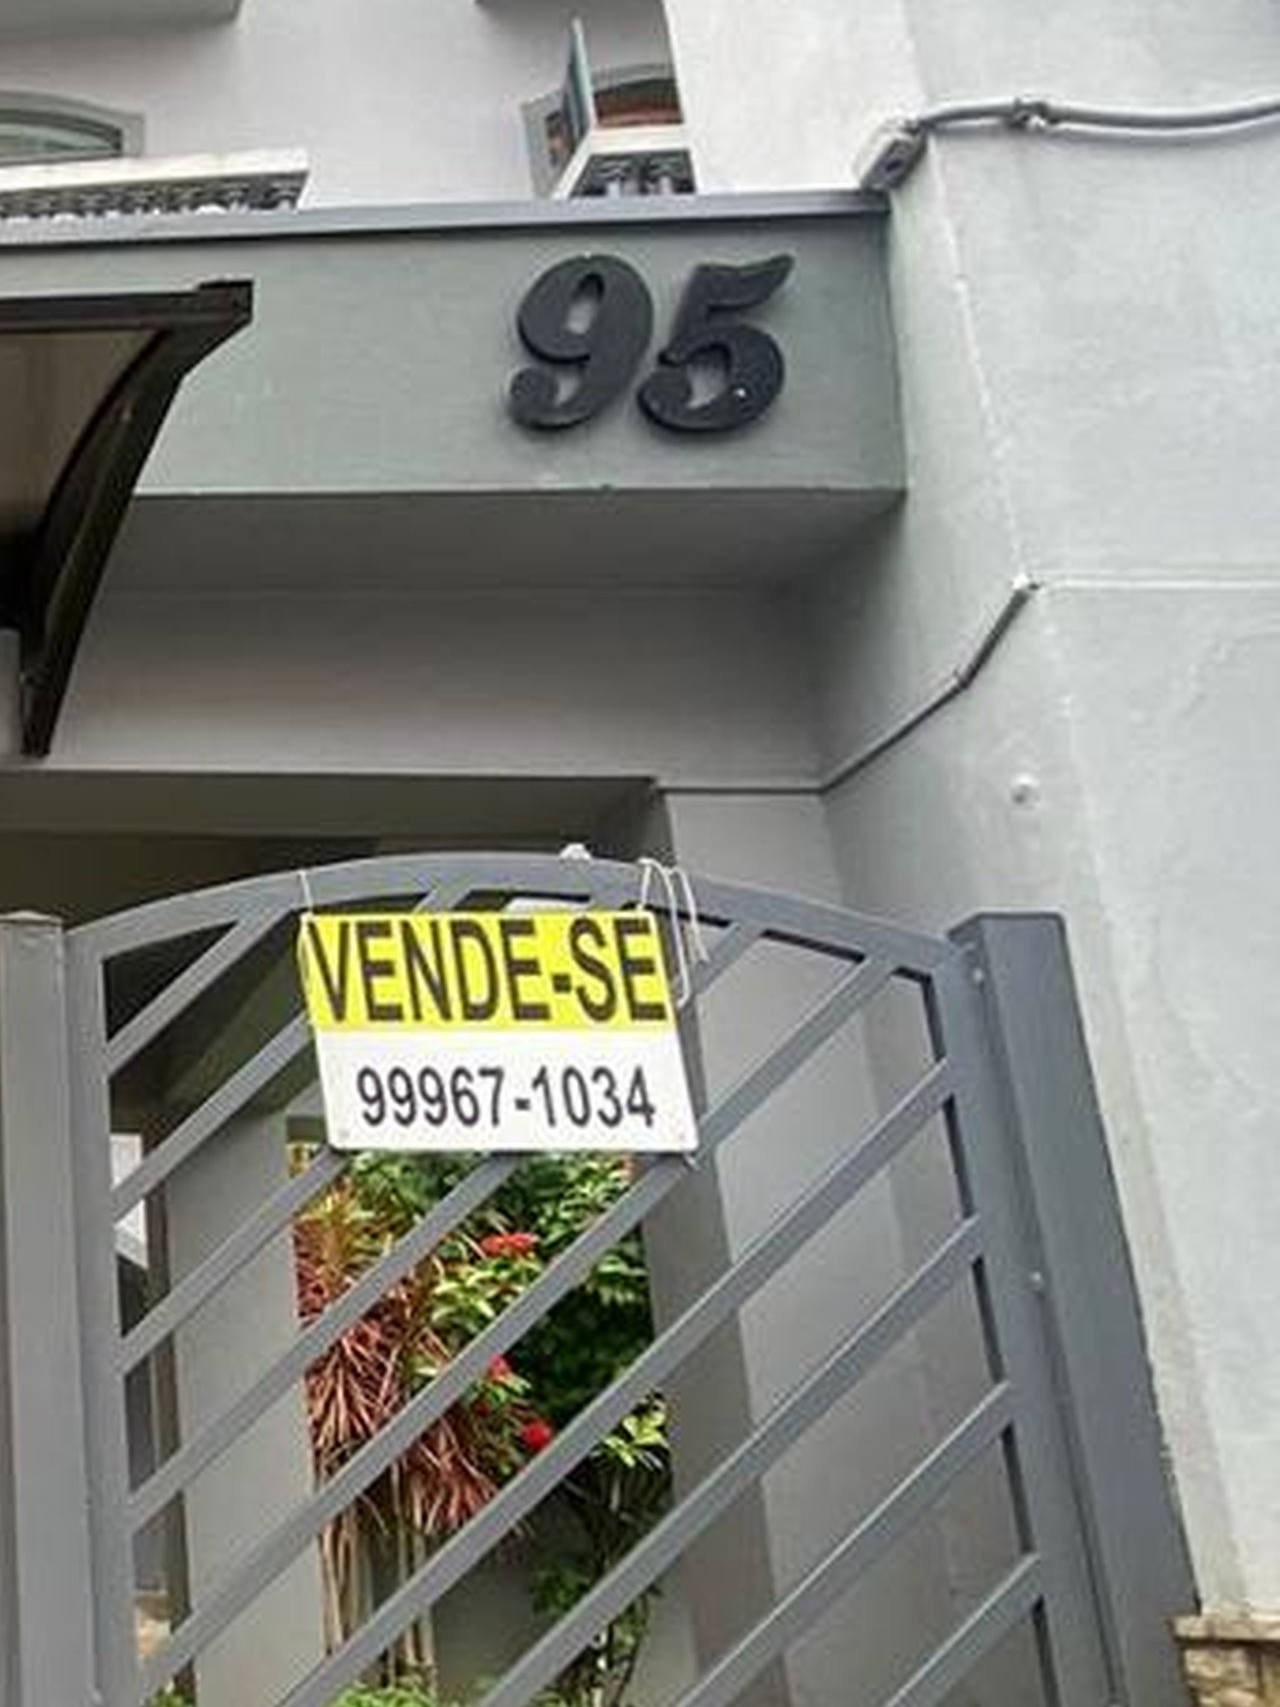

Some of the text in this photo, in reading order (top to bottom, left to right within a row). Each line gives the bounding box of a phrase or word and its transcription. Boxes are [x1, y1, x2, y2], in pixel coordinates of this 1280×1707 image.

[509, 254, 794, 432] 95
[307, 917, 668, 1023] VENDE-SE
[356, 1065, 656, 1129] 99967-1034
